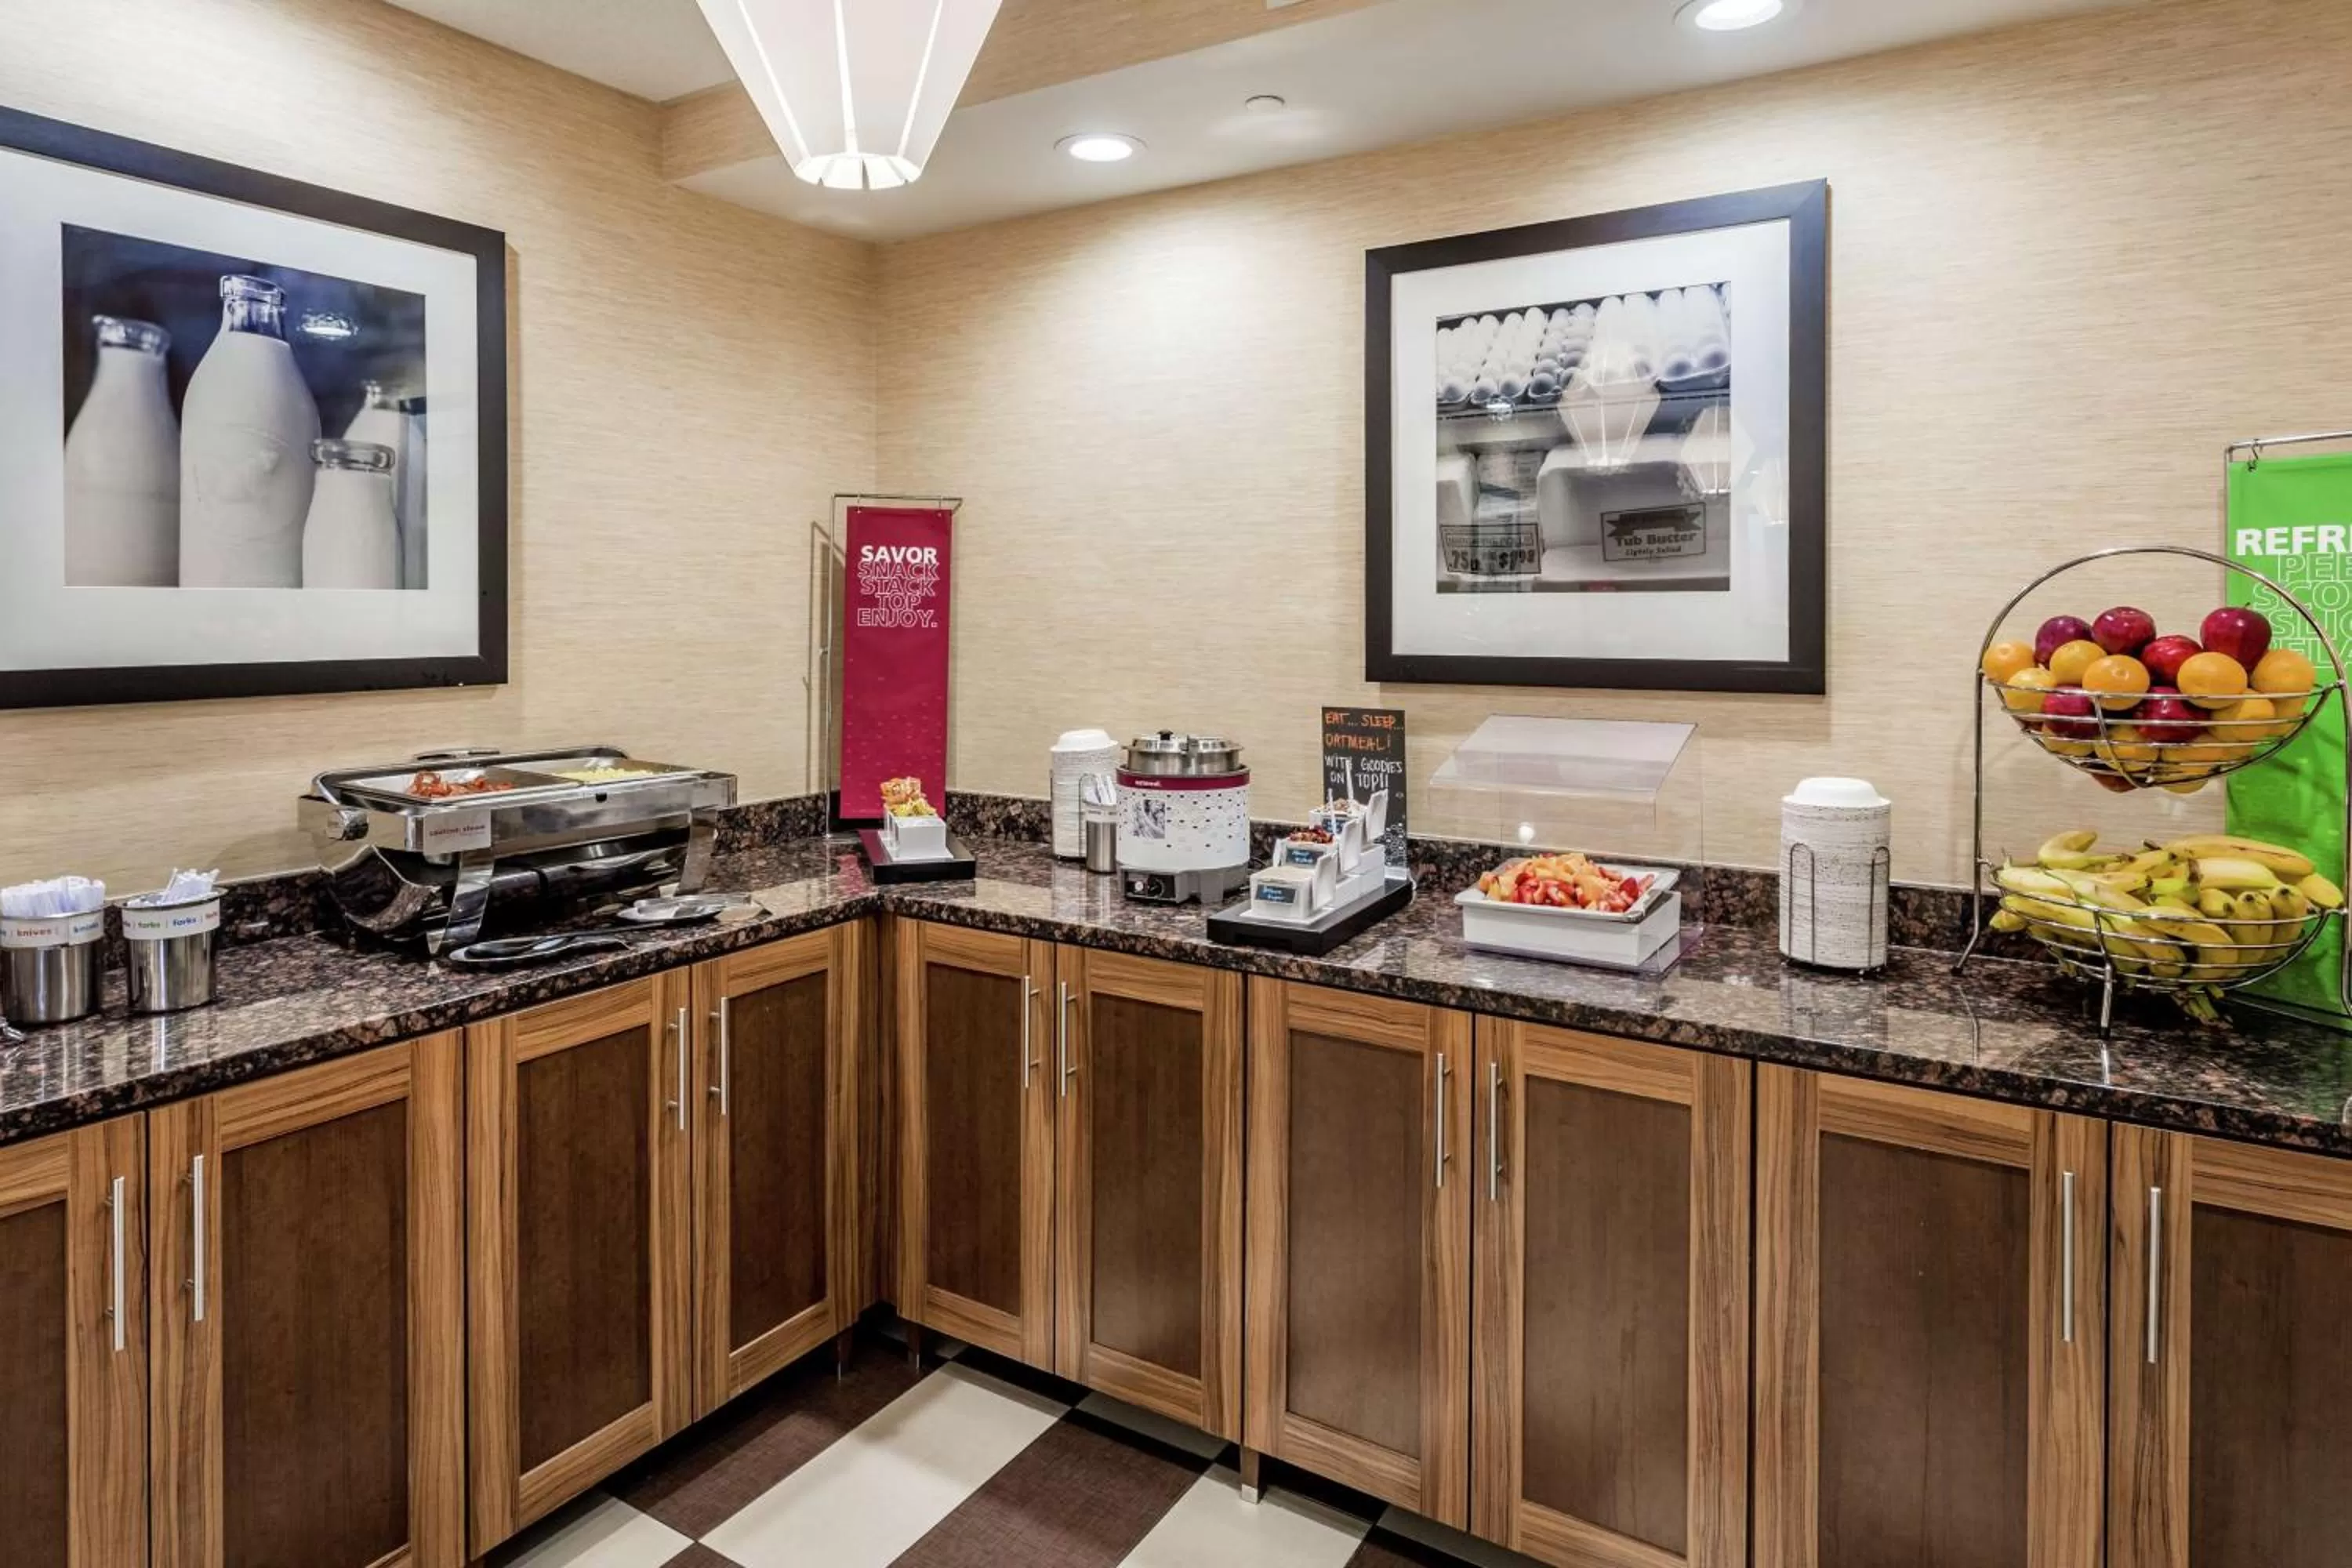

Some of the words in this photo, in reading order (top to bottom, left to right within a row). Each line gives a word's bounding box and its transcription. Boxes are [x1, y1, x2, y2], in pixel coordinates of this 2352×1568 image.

[1615, 535, 1642, 546] Tub
[1646, 533, 1697, 544] Butter
[2236, 524, 2352, 556] REFR
[861, 546, 938, 564] SAVOR
[857, 561, 940, 581] SNACK
[860, 577, 936, 597] STACK
[875, 592, 921, 611] TOP
[857, 608, 938, 628] ENJOY.
[1360, 757, 1403, 774] GOODIES
[1330, 771, 1345, 784] ON
[17, 928, 52, 937] knives
